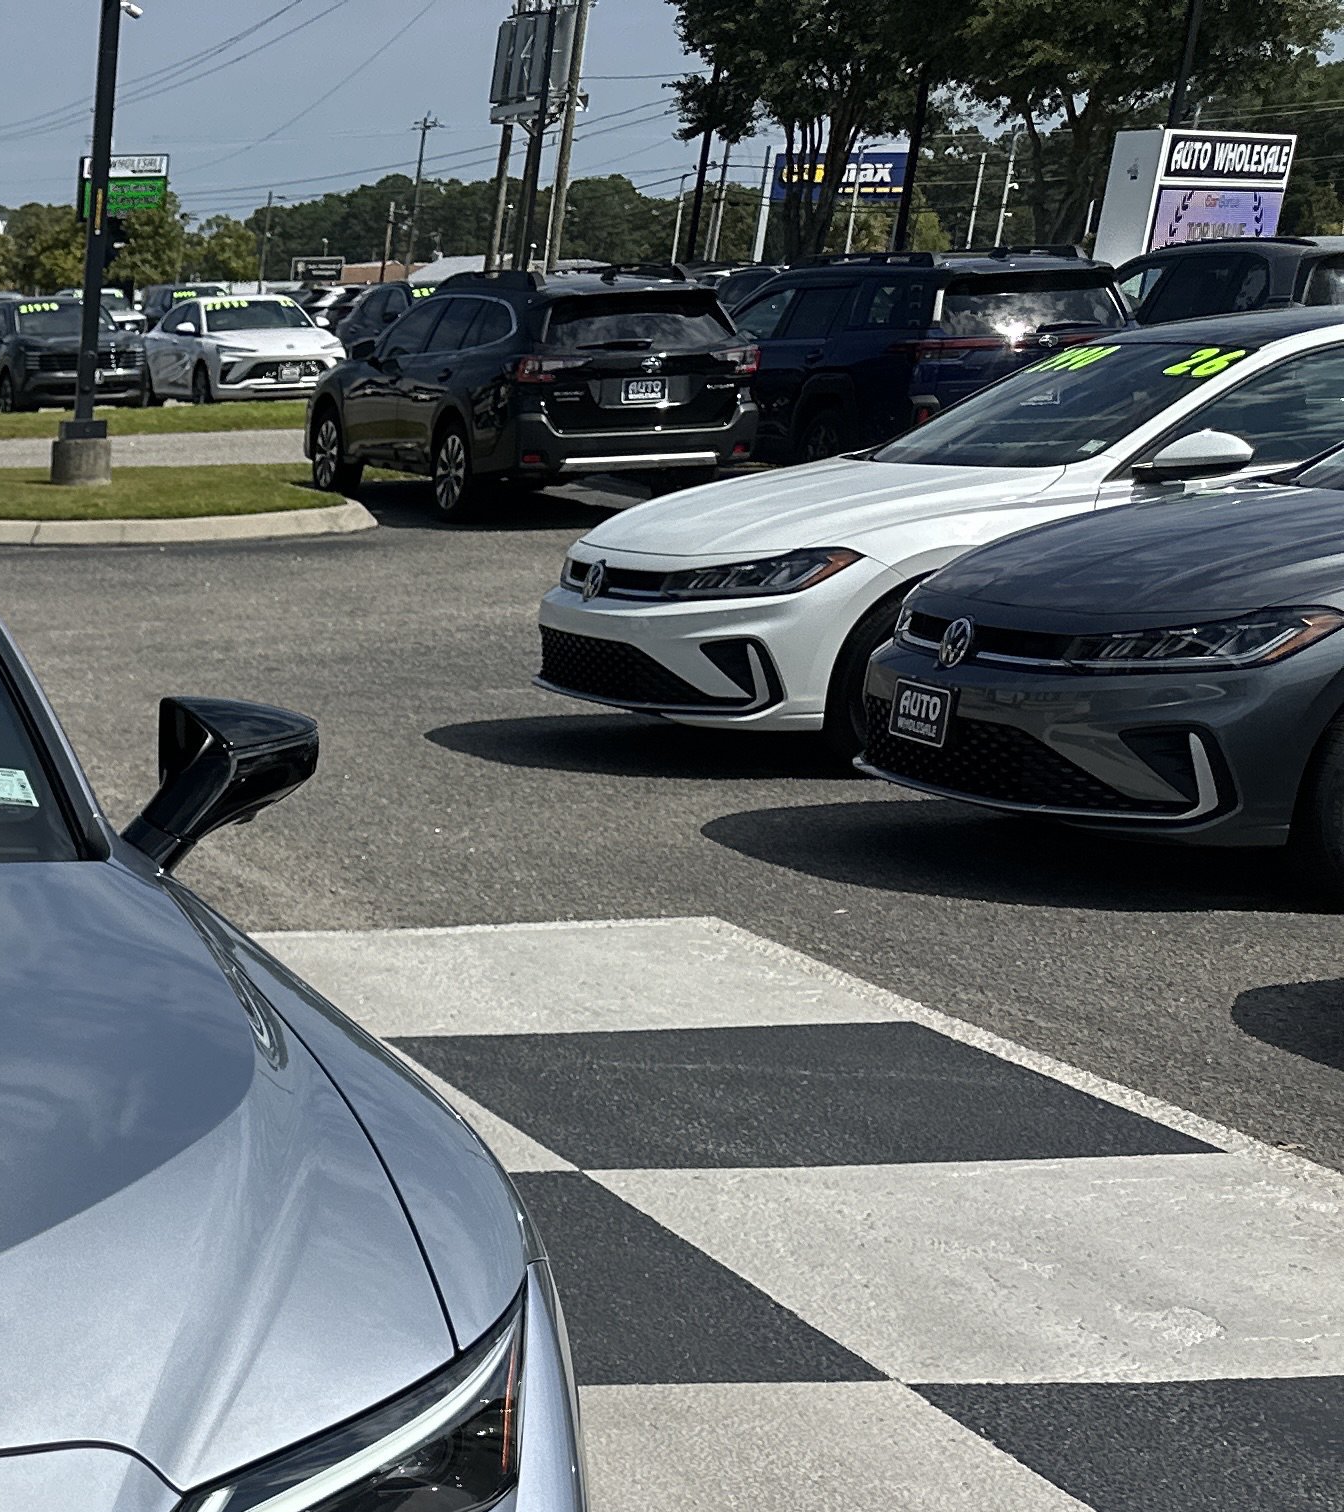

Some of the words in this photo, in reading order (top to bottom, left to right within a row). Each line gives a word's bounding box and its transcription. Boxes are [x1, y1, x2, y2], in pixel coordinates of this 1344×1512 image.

[1171, 141, 1211, 172] AUTO
[1213, 142, 1290, 174] WHOLESALE
[1163, 348, 1246, 377] 26
[628, 381, 662, 394] AUTO
[899, 690, 941, 721] AUTO
